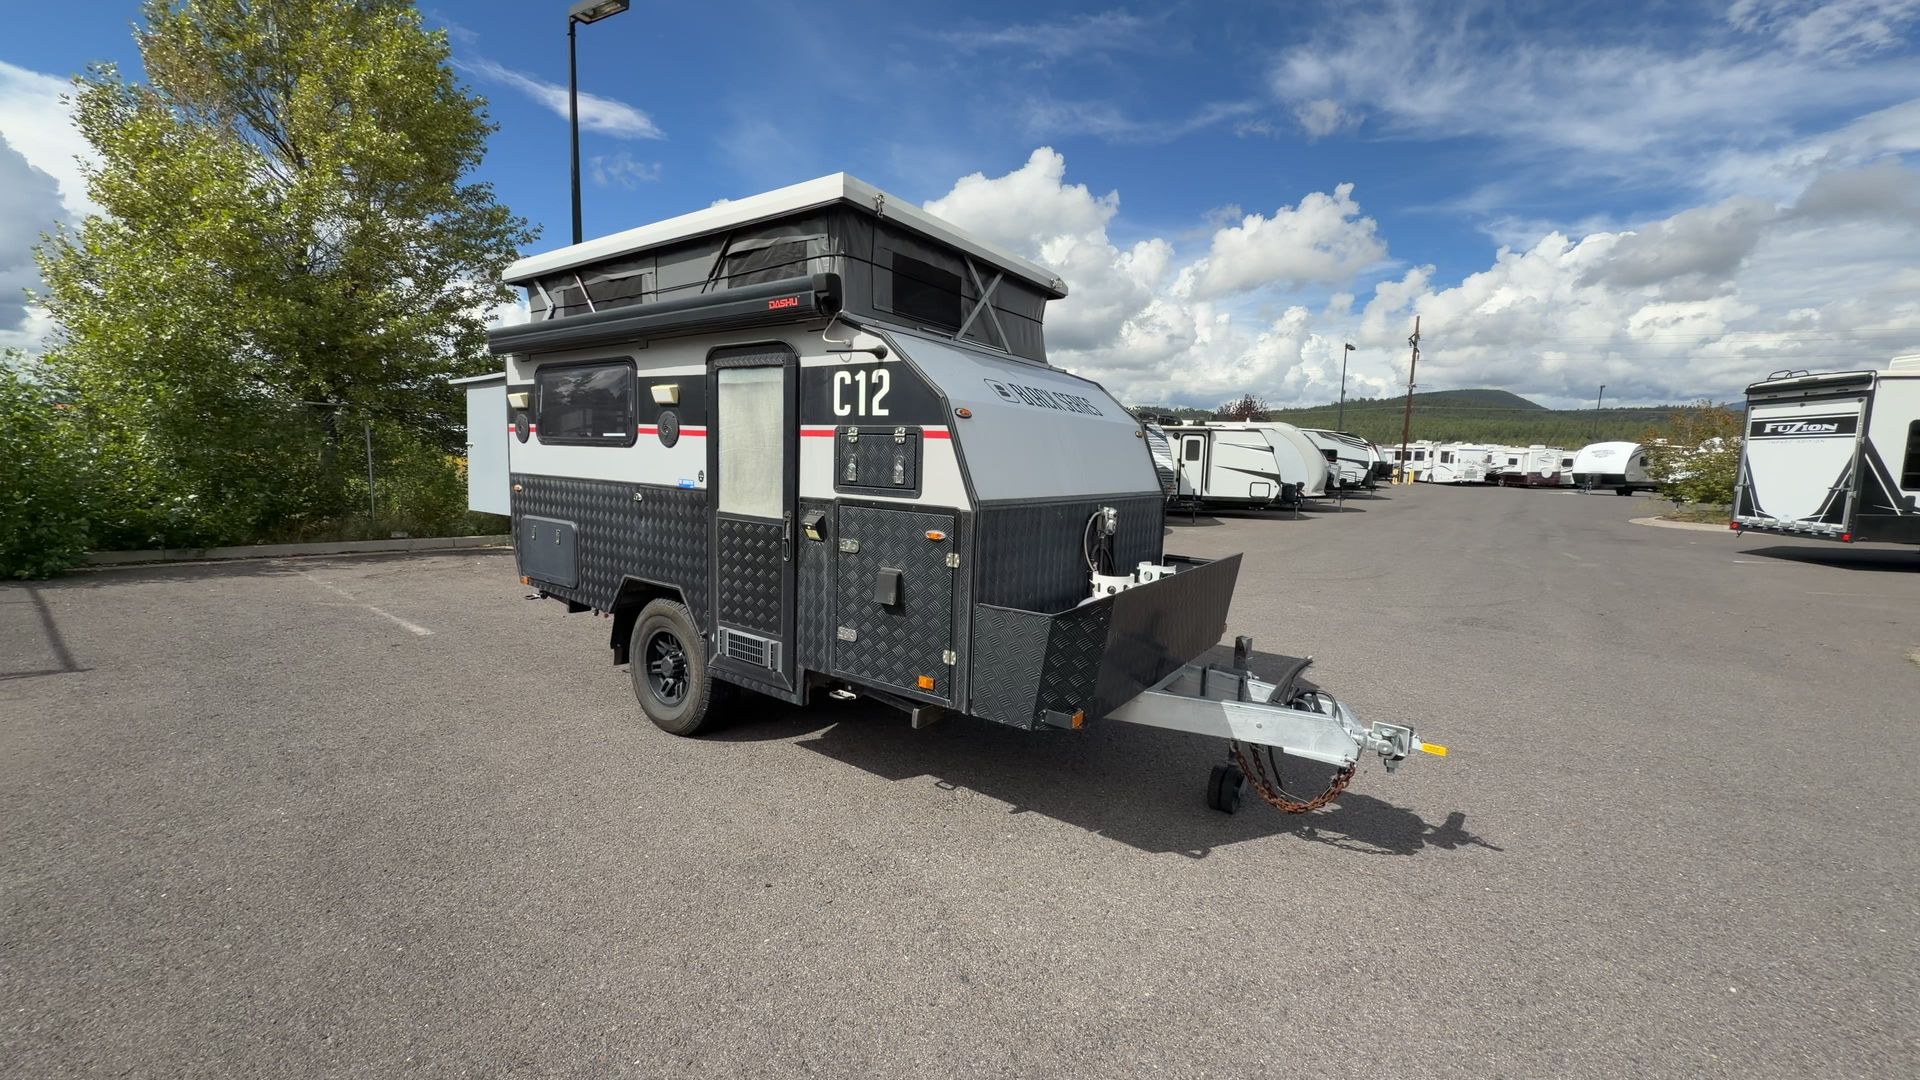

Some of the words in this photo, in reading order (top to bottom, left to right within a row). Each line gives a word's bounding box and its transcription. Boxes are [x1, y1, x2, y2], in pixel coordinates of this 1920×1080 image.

[768, 297, 798, 309] DASHU
[834, 369, 890, 416] C12
[1008, 383, 1066, 411] BLACK
[1051, 391, 1103, 416] SERIES
